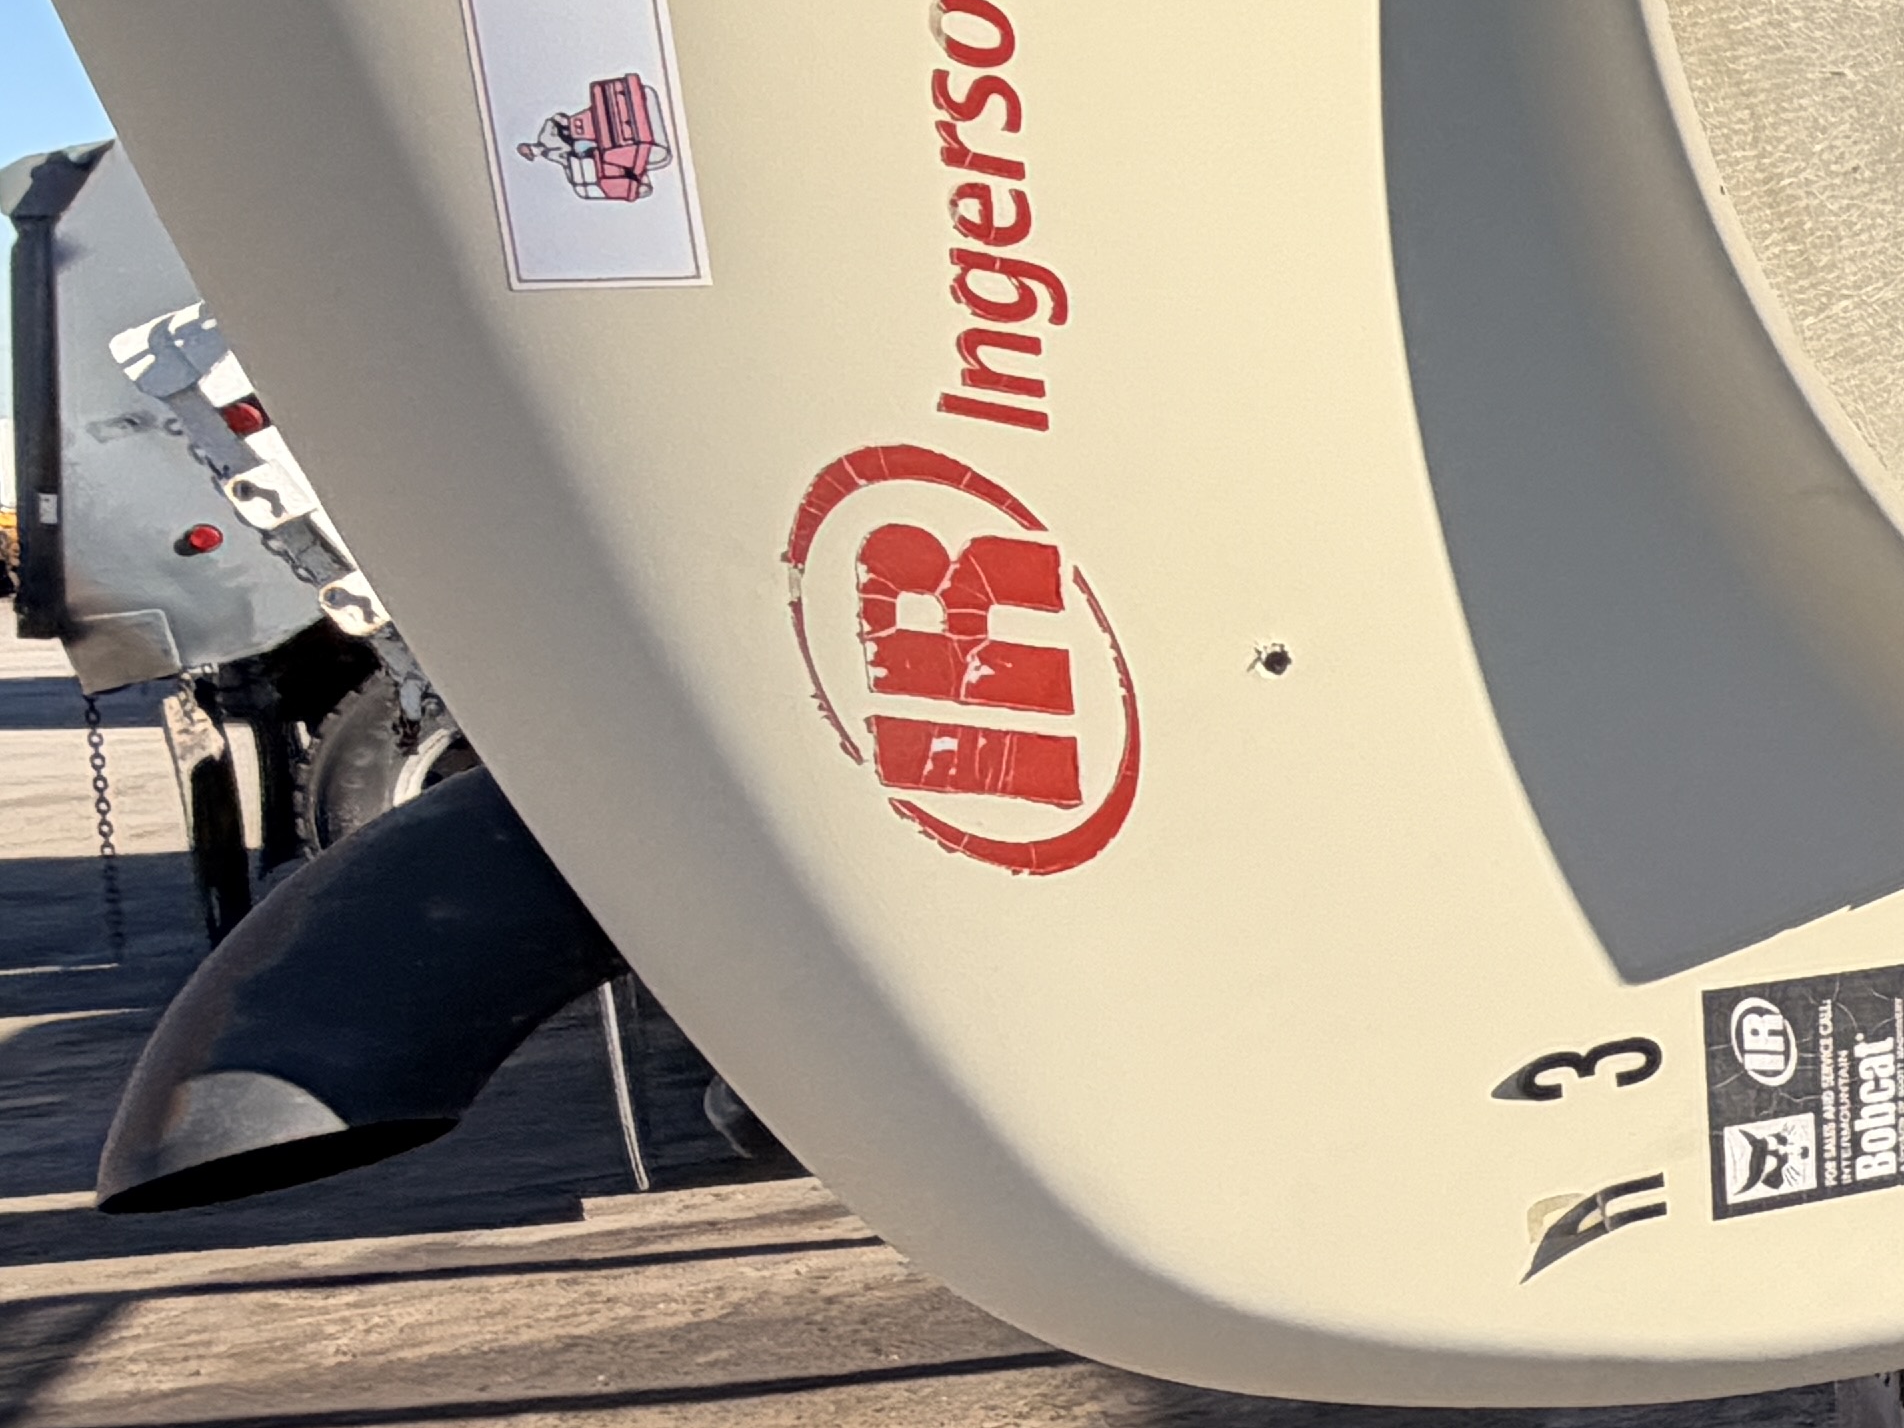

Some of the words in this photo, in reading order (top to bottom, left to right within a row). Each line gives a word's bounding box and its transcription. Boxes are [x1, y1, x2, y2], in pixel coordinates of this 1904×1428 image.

[1494, 1036, 1662, 1102] 3
[1741, 1008, 1786, 1076] IR
[1818, 1035, 1835, 1088] SERVICE
[1821, 1088, 1836, 1121] AND
[1836, 1048, 1852, 1184] INTERMOUNTAIN
[1851, 1035, 1897, 1181] Bobcat
[1822, 1121, 1837, 1159] SALES
[1823, 1159, 1838, 1187] FOR
